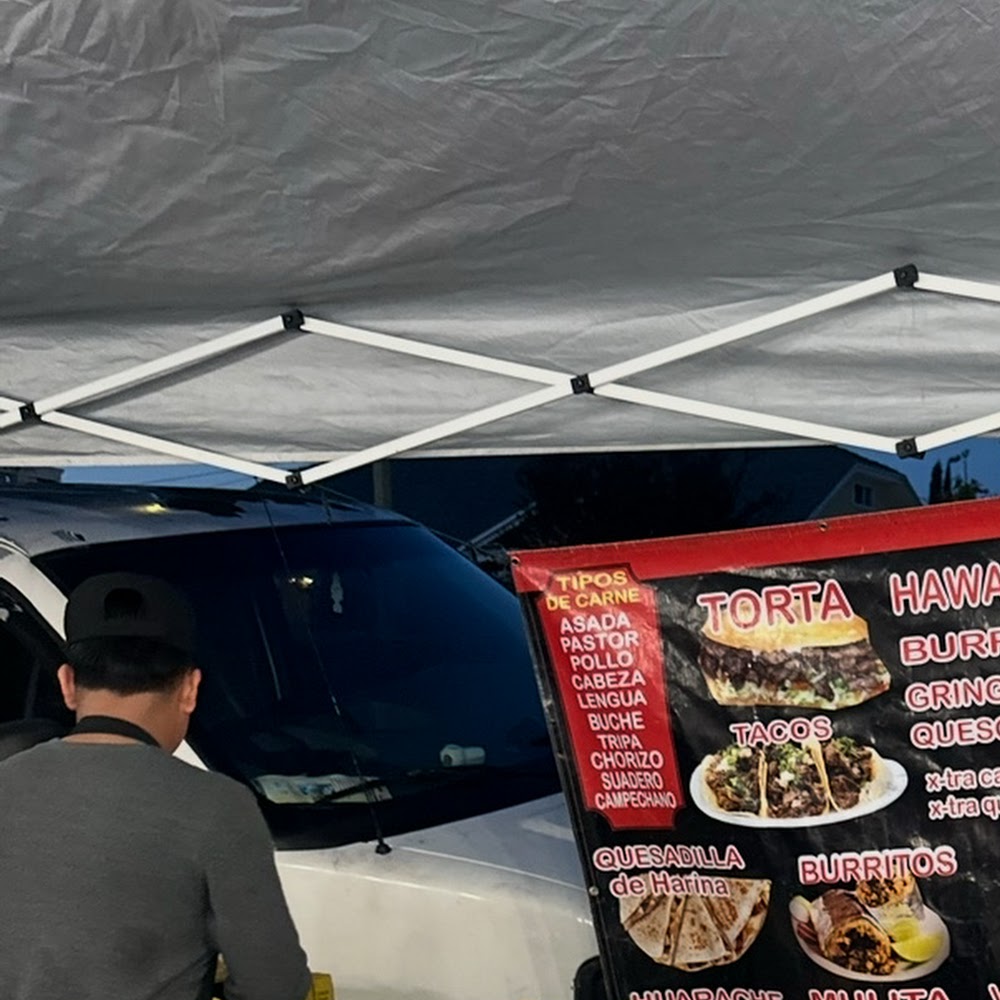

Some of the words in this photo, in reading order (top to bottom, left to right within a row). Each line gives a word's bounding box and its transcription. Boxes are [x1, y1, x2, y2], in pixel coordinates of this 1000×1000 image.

[557, 570, 628, 591] TIPOS
[546, 593, 571, 611] DE
[575, 588, 641, 608] CARNE
[697, 578, 854, 633] TORTA
[560, 611, 632, 635] ASADA
[560, 630, 639, 653] PASTOR
[570, 650, 634, 671] POLLO
[571, 669, 647, 690] CABEZA
[576, 689, 648, 709] LENGUA
[587, 711, 645, 731] BUCHE
[730, 715, 833, 747] TACOS
[597, 733, 643, 750] TRIPA
[590, 750, 664, 770] CHORIZO
[601, 771, 663, 791] SUADERO
[925, 767, 977, 792] x-tra
[595, 791, 677, 811] CAMPECHANO
[929, 795, 980, 820] x-tra
[594, 845, 745, 871] QUESADILLA
[798, 845, 958, 886] BURRITOS
[610, 872, 644, 898] de
[649, 871, 730, 896] Harina
